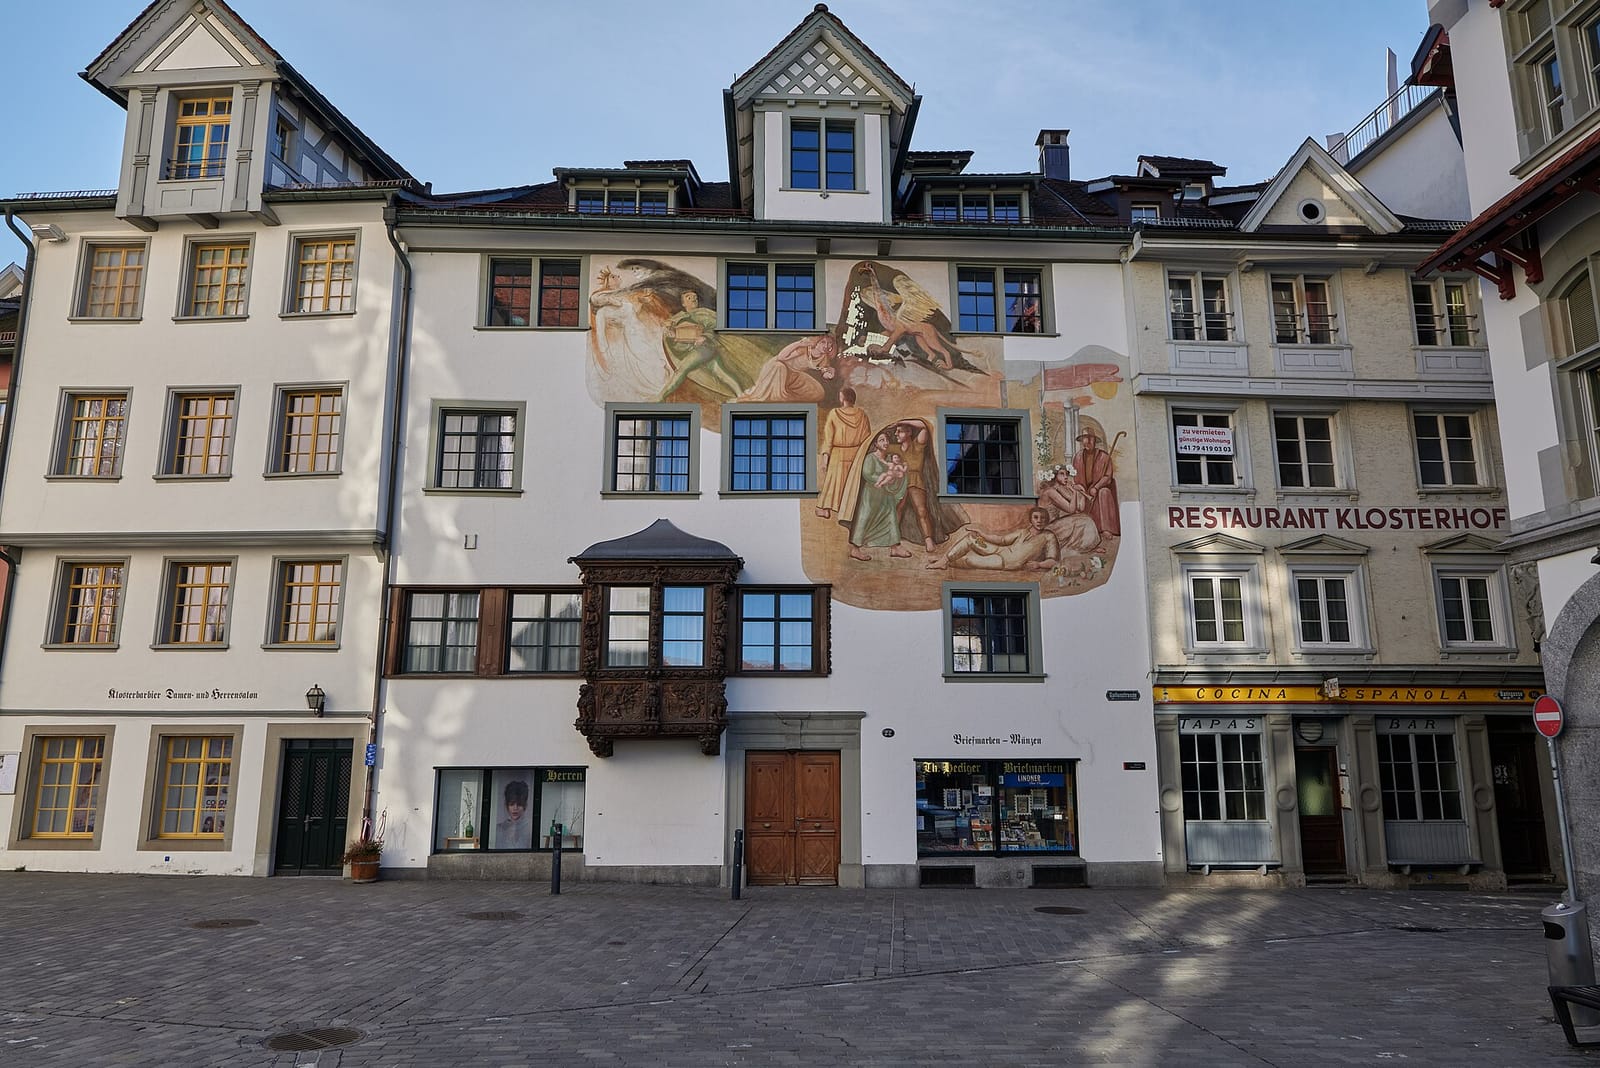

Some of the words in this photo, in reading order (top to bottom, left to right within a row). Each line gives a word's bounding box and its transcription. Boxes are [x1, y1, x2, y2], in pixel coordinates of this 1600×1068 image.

[1204, 437, 1231, 445] Wohnung
[1168, 506, 1329, 529] RESTAURANT
[1337, 507, 1506, 530] KLOSTERHOF
[108, 687, 161, 699] Klosterbarbier
[196, 690, 209, 699] und
[211, 688, 258, 700] Herrensalon
[1196, 687, 1287, 699] COCINA
[1339, 687, 1468, 700] ESPAÑOLA
[1180, 718, 1255, 730] TAPAS
[1389, 719, 1437, 730] BAR
[953, 733, 1000, 746] Briefmarken
[1010, 733, 1042, 746] Münzen
[1004, 761, 1063, 774] Briefmarken
[546, 769, 583, 782] Herren
[1017, 774, 1041, 782] LINDNER
